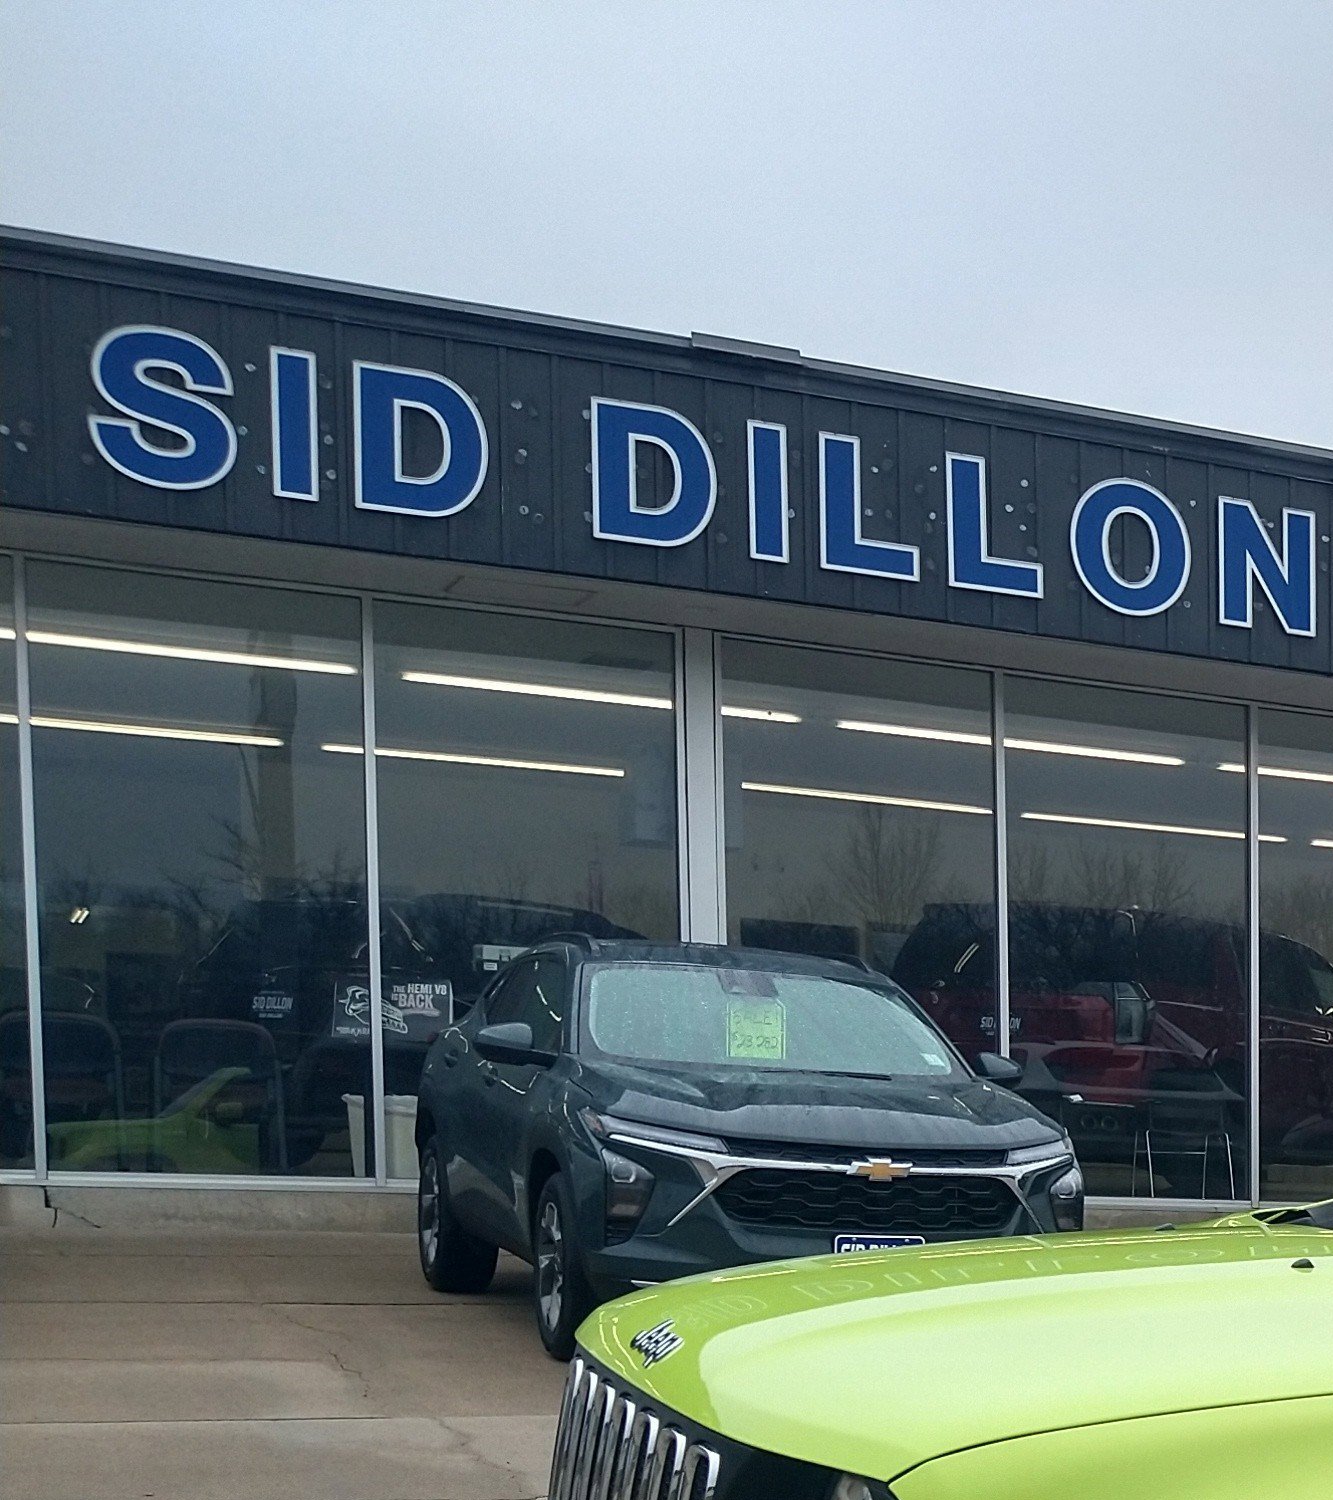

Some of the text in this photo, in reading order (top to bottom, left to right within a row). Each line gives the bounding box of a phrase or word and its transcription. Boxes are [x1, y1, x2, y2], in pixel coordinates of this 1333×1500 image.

[87, 324, 1317, 638] SID DILLON
[407, 983, 432, 995] HEMI
[399, 994, 434, 1010] BACK
